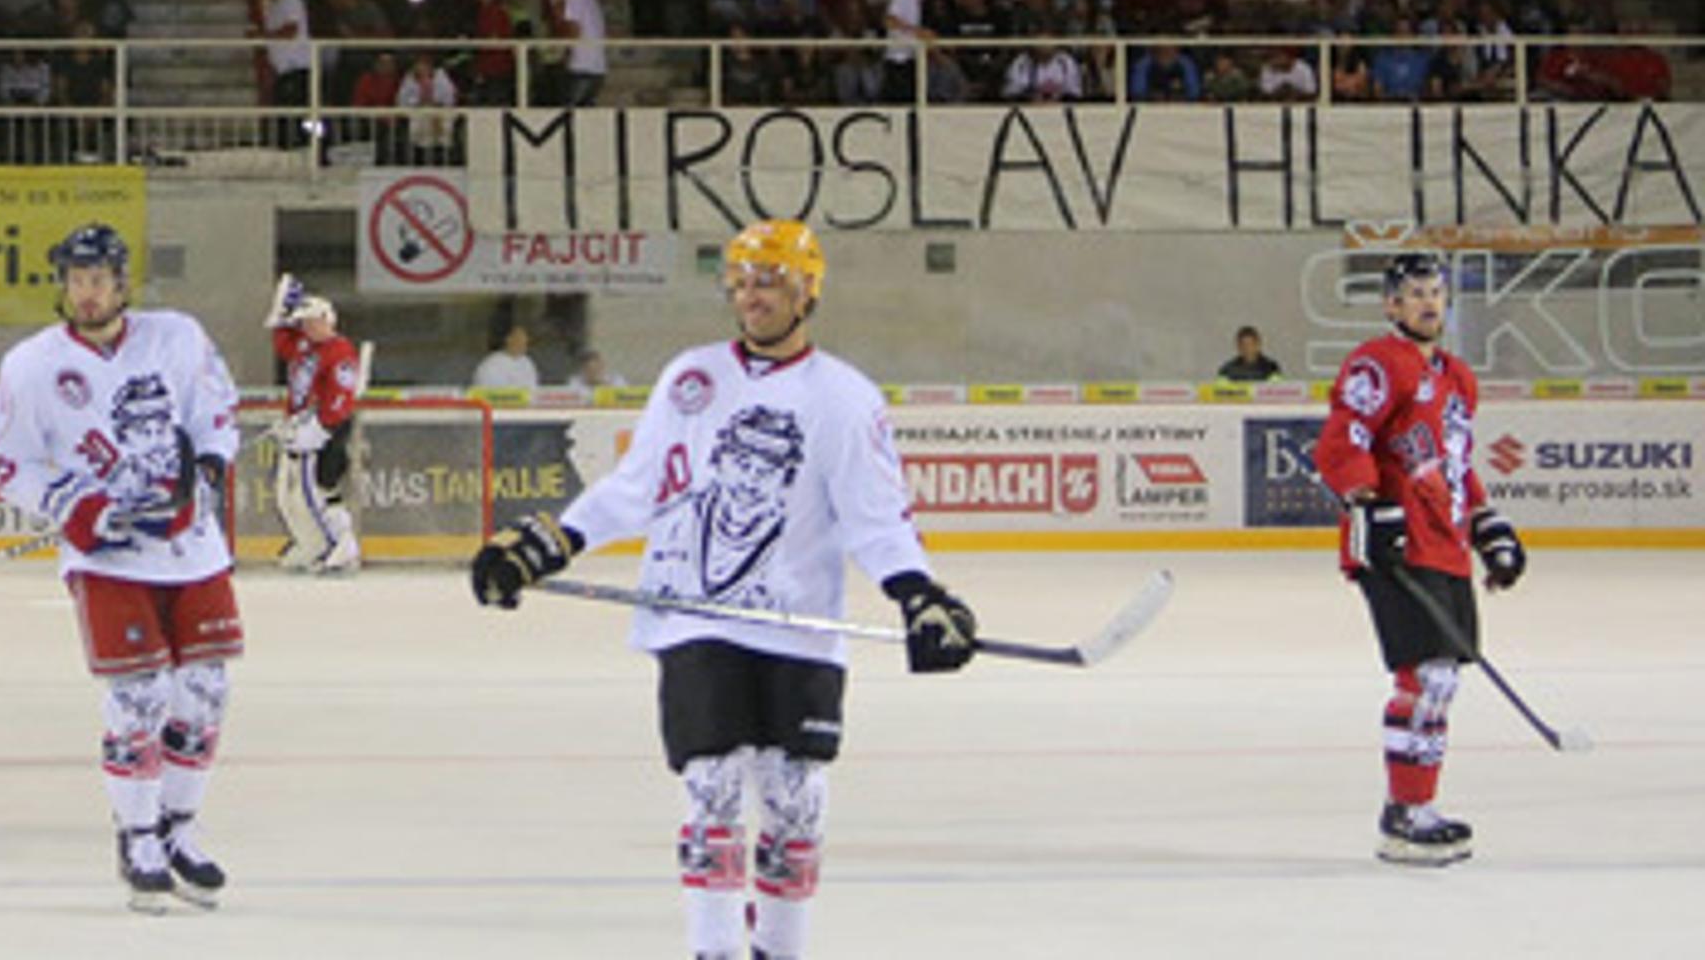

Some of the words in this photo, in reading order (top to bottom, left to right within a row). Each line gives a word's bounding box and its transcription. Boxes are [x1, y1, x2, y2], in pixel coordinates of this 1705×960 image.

[502, 107, 1137, 233] MIROSLAV
[1225, 104, 1705, 229] HLINKA
[1535, 442, 1693, 470] SUZUKI
[1487, 478, 1693, 505] www.proauto.sk
